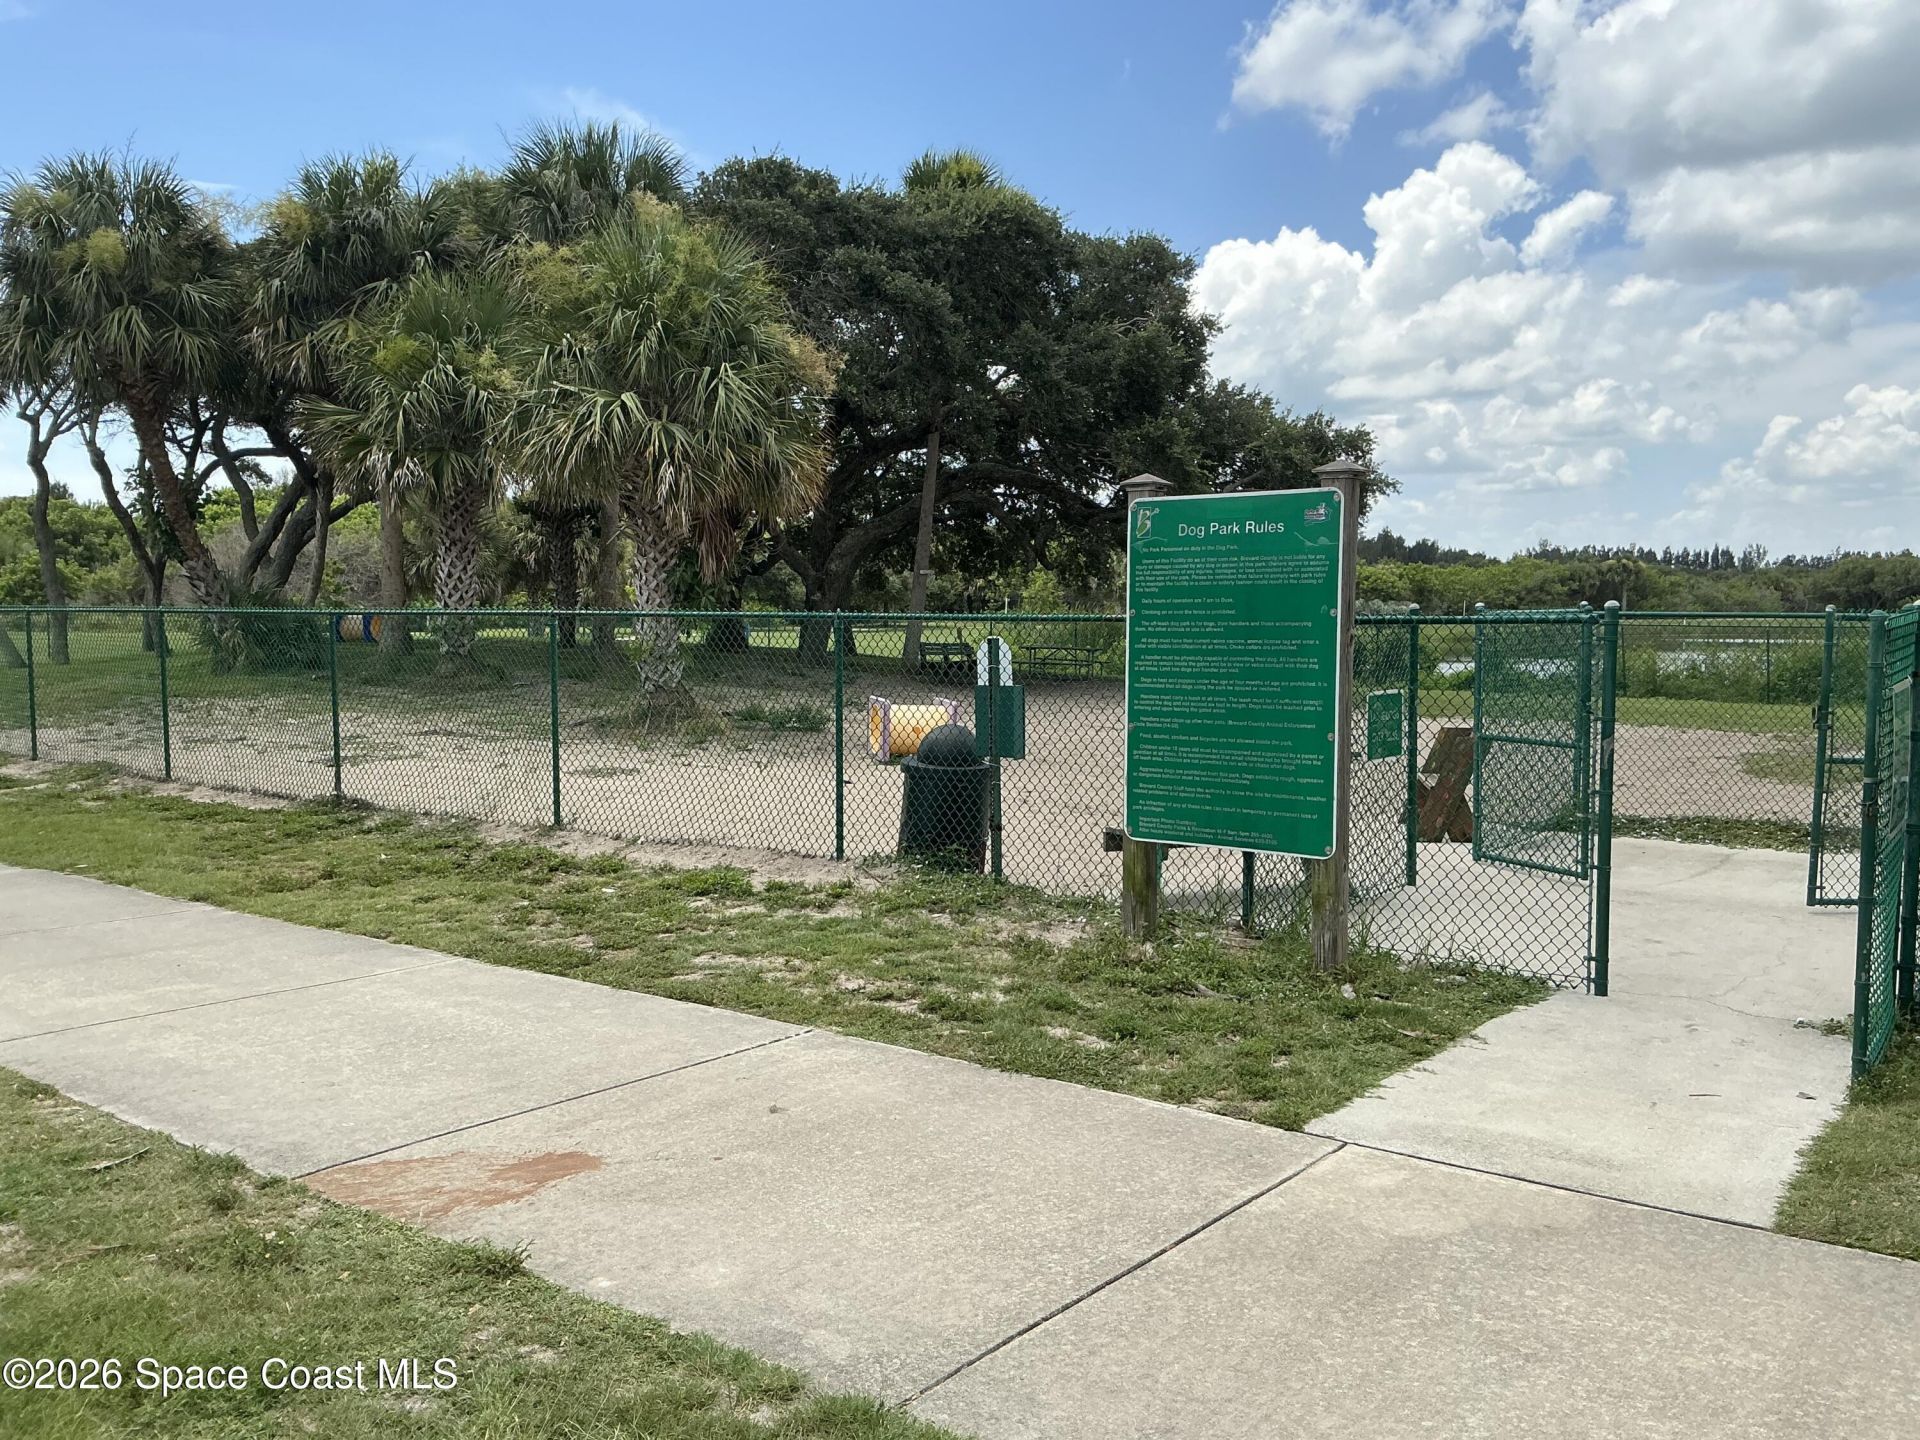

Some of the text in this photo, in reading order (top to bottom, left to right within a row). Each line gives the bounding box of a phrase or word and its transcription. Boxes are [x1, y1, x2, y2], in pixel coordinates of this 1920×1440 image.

[1178, 520, 1284, 538] Dog Park Rules
